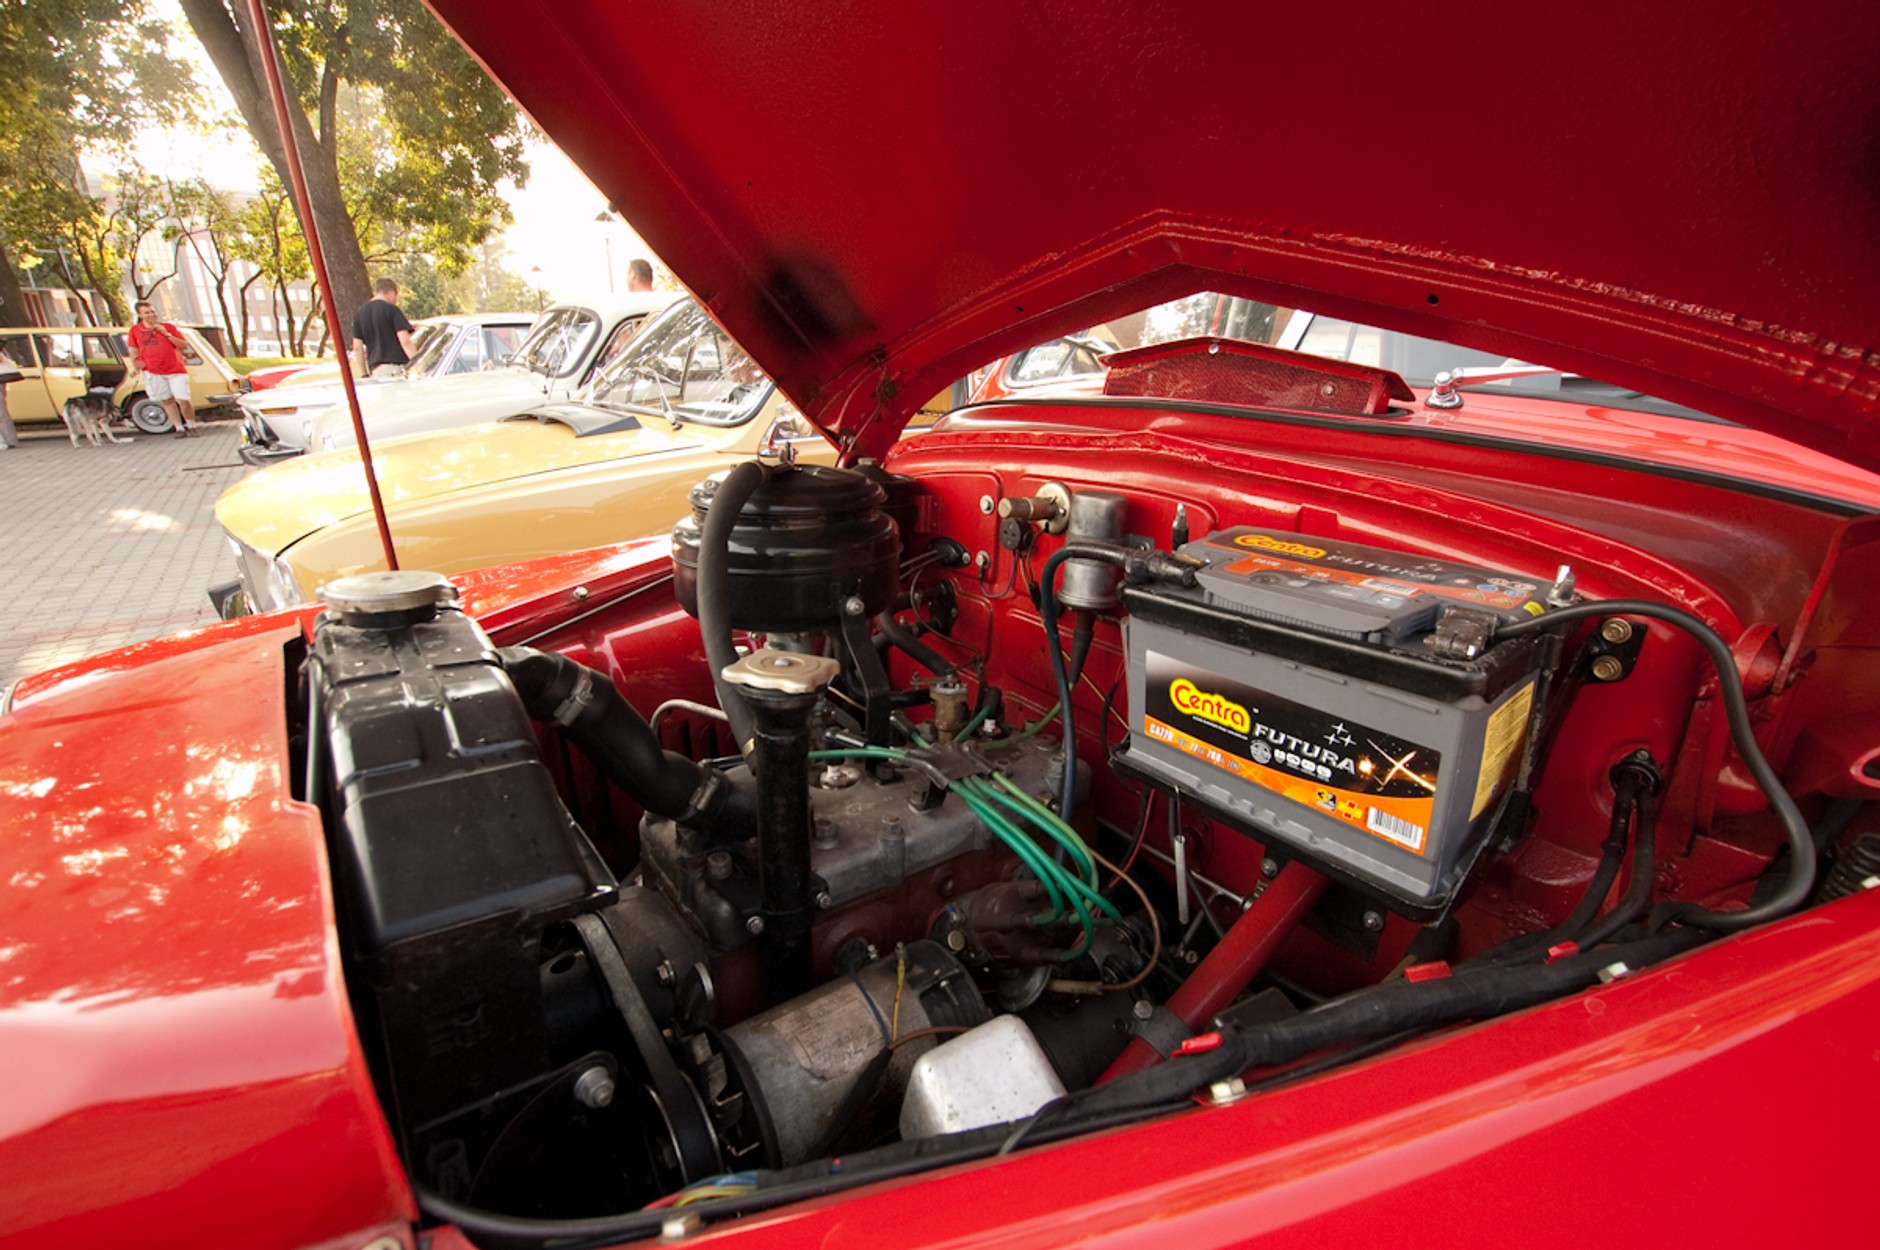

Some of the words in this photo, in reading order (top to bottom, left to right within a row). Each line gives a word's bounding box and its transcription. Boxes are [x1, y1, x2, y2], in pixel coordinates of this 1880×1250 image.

[1237, 535, 1321, 557] Centra
[1326, 554, 1437, 581] FUTURA
[1173, 683, 1246, 728] Centra
[1252, 722, 1356, 775] FUTURA
